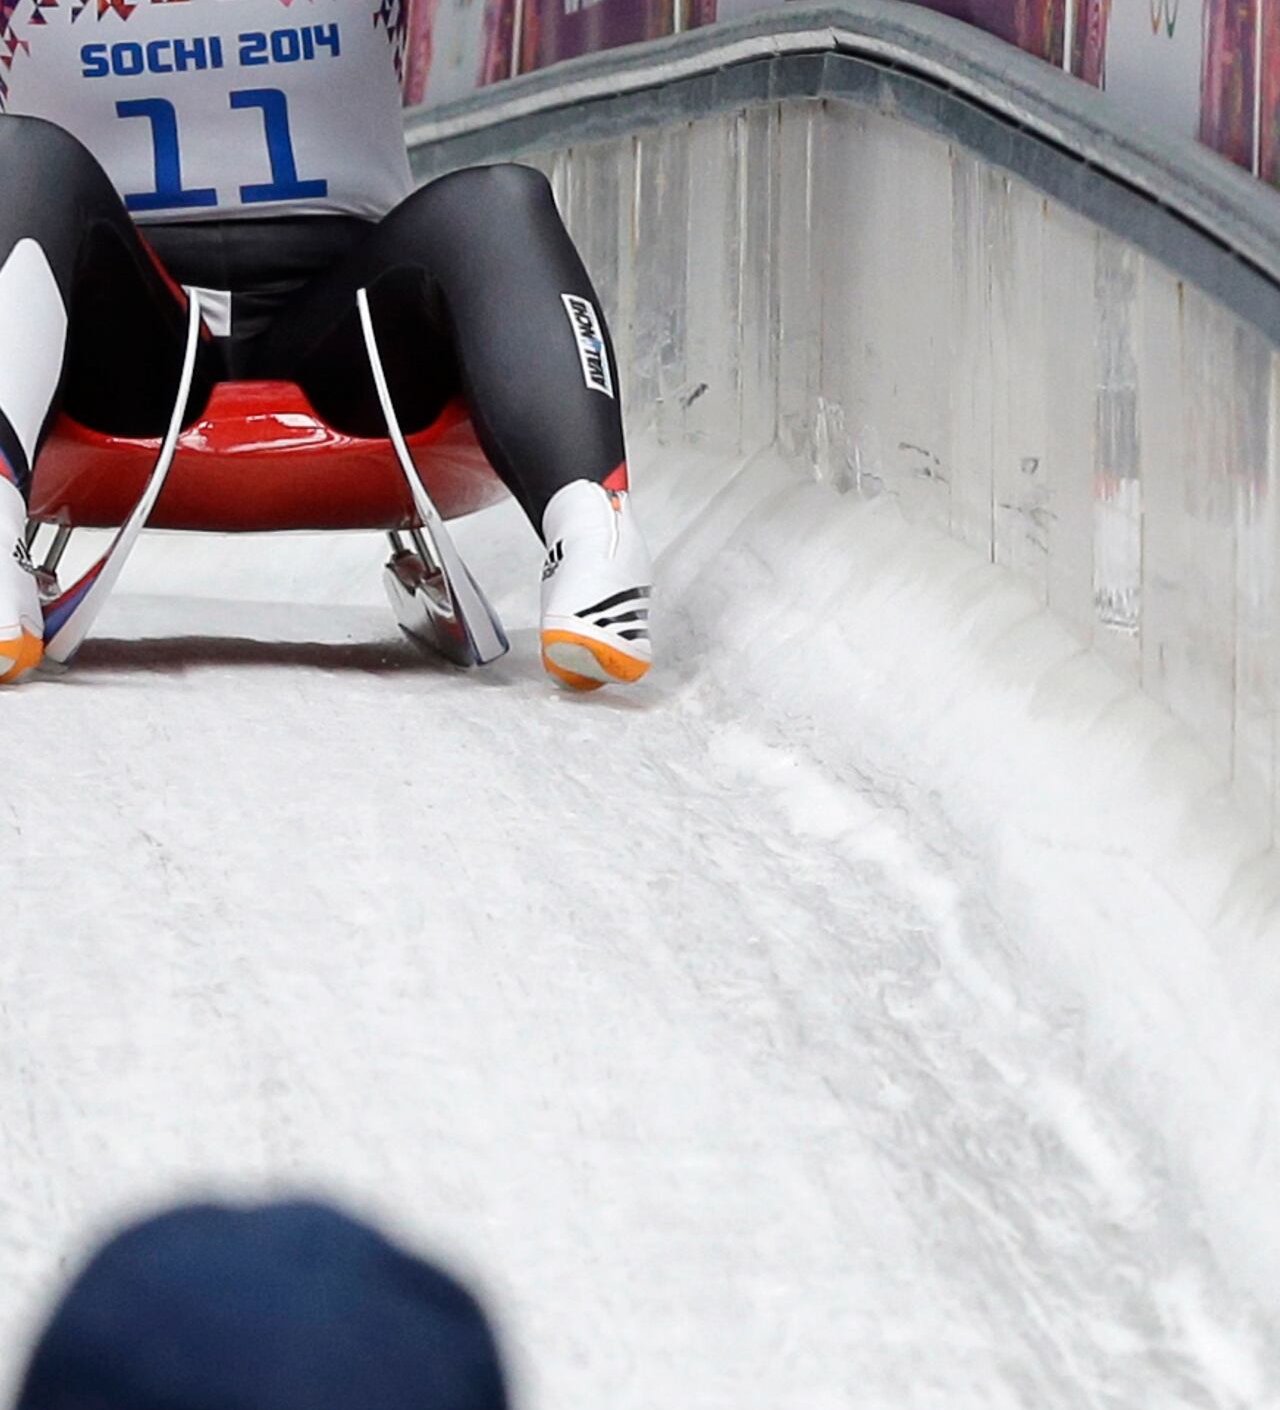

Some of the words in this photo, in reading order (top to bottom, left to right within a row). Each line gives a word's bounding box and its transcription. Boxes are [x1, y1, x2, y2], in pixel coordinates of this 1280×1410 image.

[80, 36, 223, 78] SOCHI
[237, 22, 341, 66] 2014
[115, 87, 328, 212] 11
